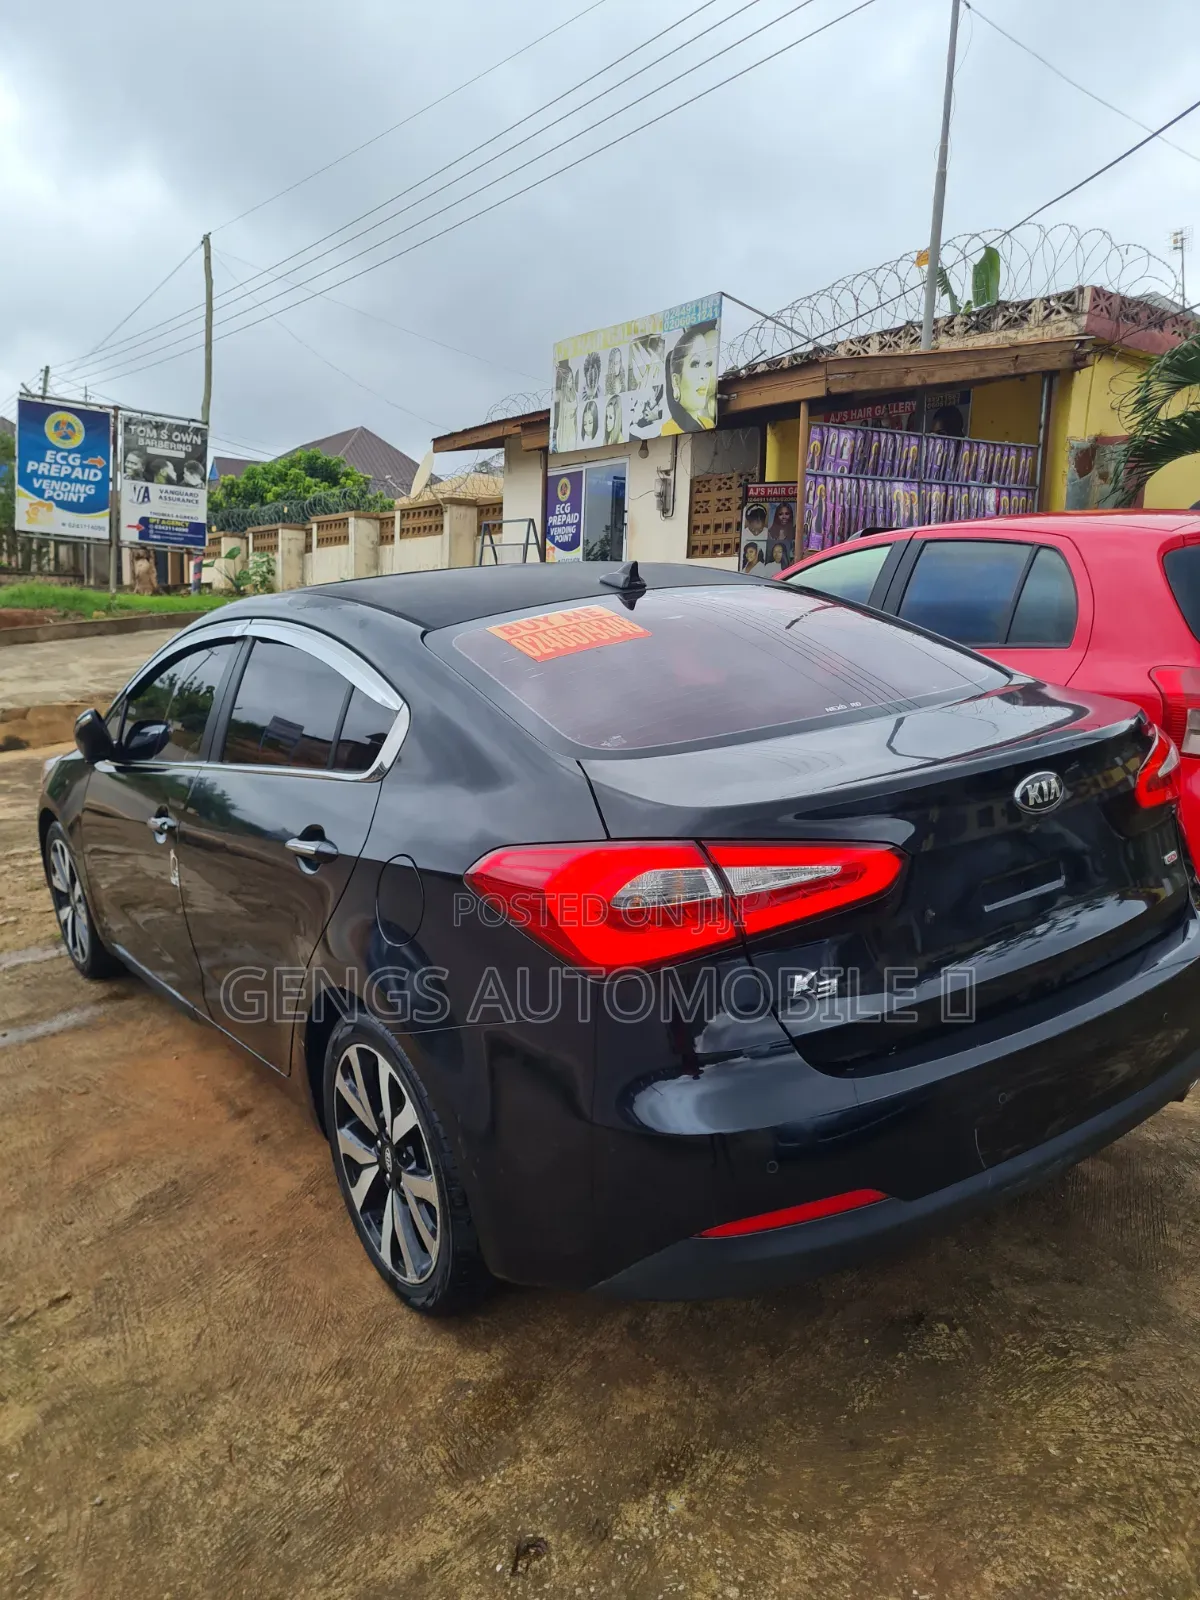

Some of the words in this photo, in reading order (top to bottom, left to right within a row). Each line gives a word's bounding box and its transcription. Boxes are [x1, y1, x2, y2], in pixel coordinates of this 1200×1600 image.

[829, 411, 848, 423] AJ'S
[850, 407, 872, 420] HAIR
[138, 437, 192, 453] BARBERING
[171, 431, 202, 445] OWN
[45, 450, 82, 466] ECG
[26, 460, 103, 482] PREPAID
[32, 477, 96, 495] VENDING
[159, 488, 199, 498] VANGUARD
[748, 487, 765, 496] AJ'S
[767, 487, 786, 495] HAIR
[44, 489, 87, 503] POINT
[158, 495, 200, 505] ASSURANCE
[555, 502, 571, 515] ECG
[160, 519, 190, 528] AGENCY
[547, 512, 580, 527] PREPAID
[550, 525, 576, 536] VENDING
[554, 533, 573, 544] POINT
[500, 615, 555, 636] BUY
[562, 607, 605, 622] ME
[1025, 778, 1060, 806] KIA
[793, 970, 838, 1000] K3
